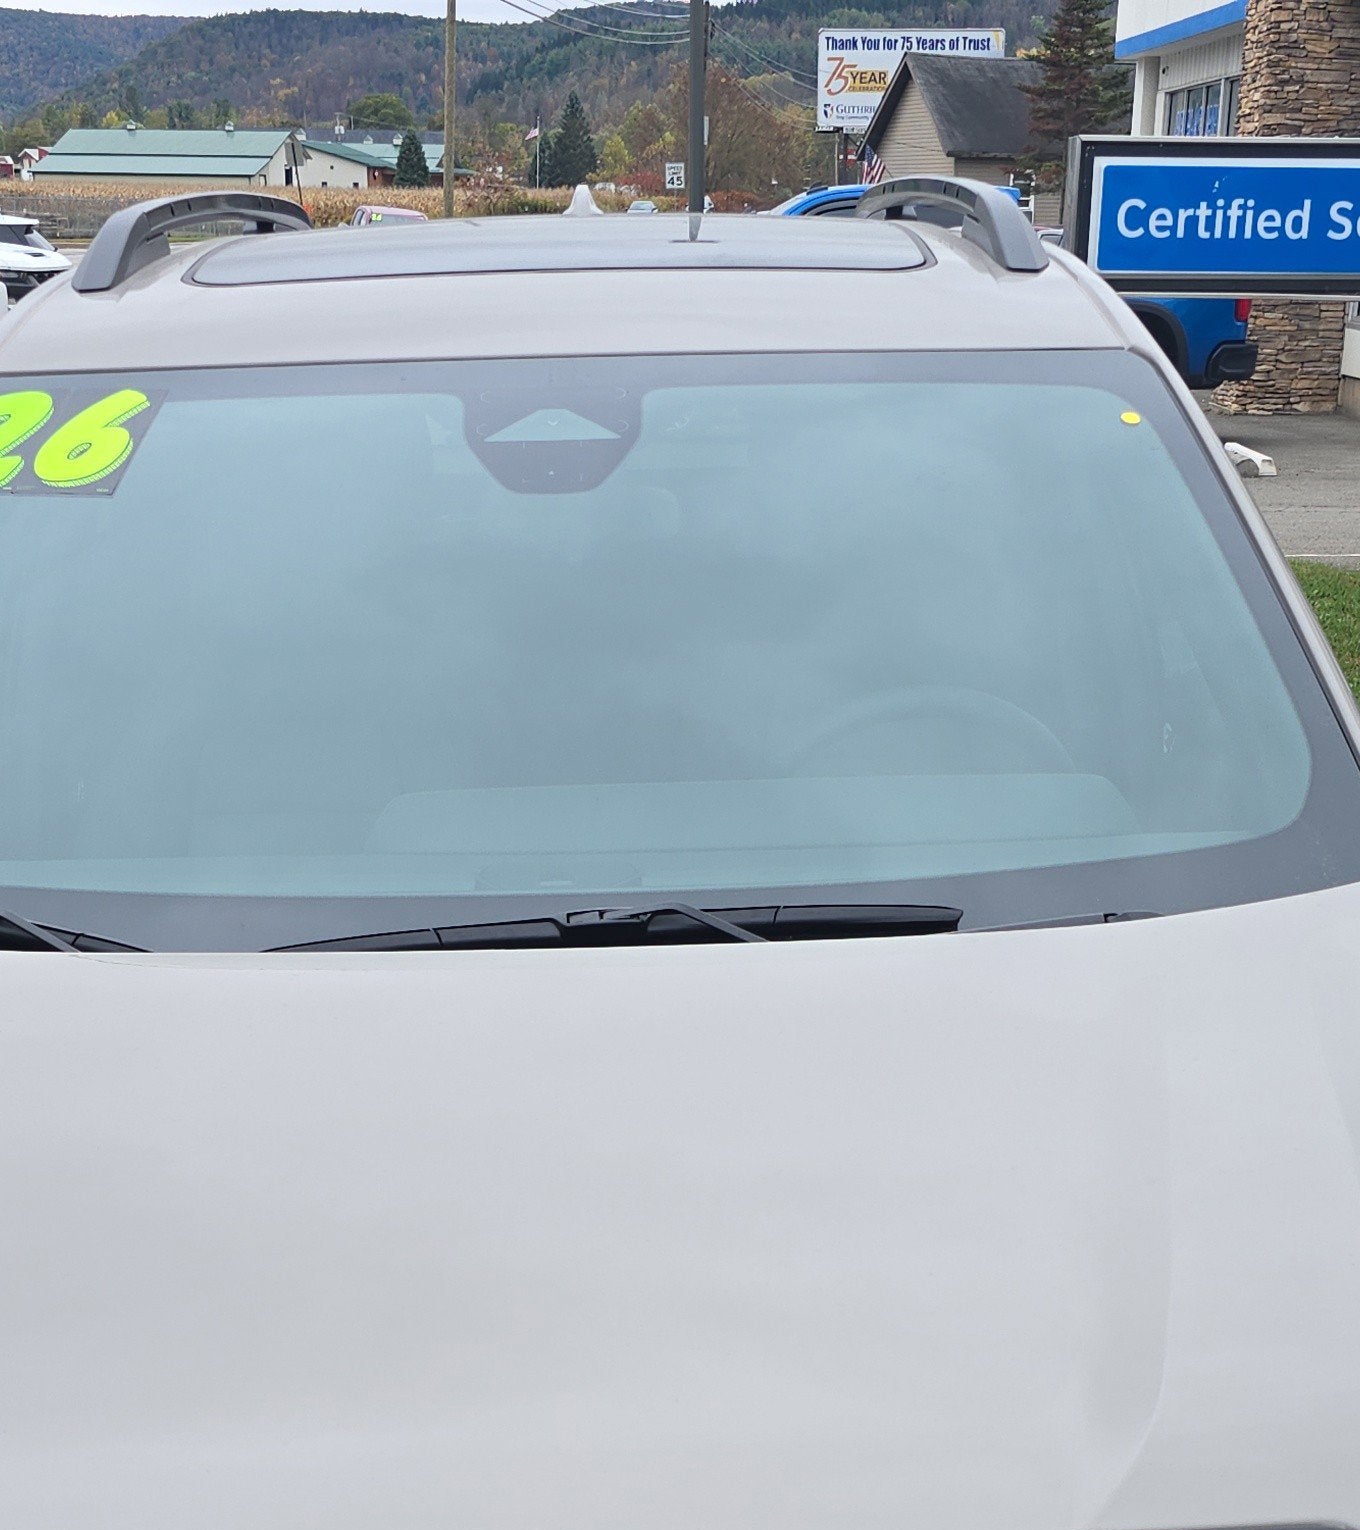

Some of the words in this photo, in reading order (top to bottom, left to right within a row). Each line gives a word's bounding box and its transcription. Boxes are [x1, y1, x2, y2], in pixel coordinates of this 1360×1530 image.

[825, 36, 858, 51] Thank
[860, 36, 880, 51] You
[883, 36, 898, 51] for
[901, 36, 913, 51] 75
[916, 36, 946, 51] Years
[949, 36, 960, 51] of
[962, 36, 991, 51] Trust
[824, 57, 858, 96] 75
[850, 71, 887, 86] YEAR
[836, 103, 877, 114] GUTHRI
[667, 176, 683, 187] 45
[1116, 198, 1311, 240] Certified
